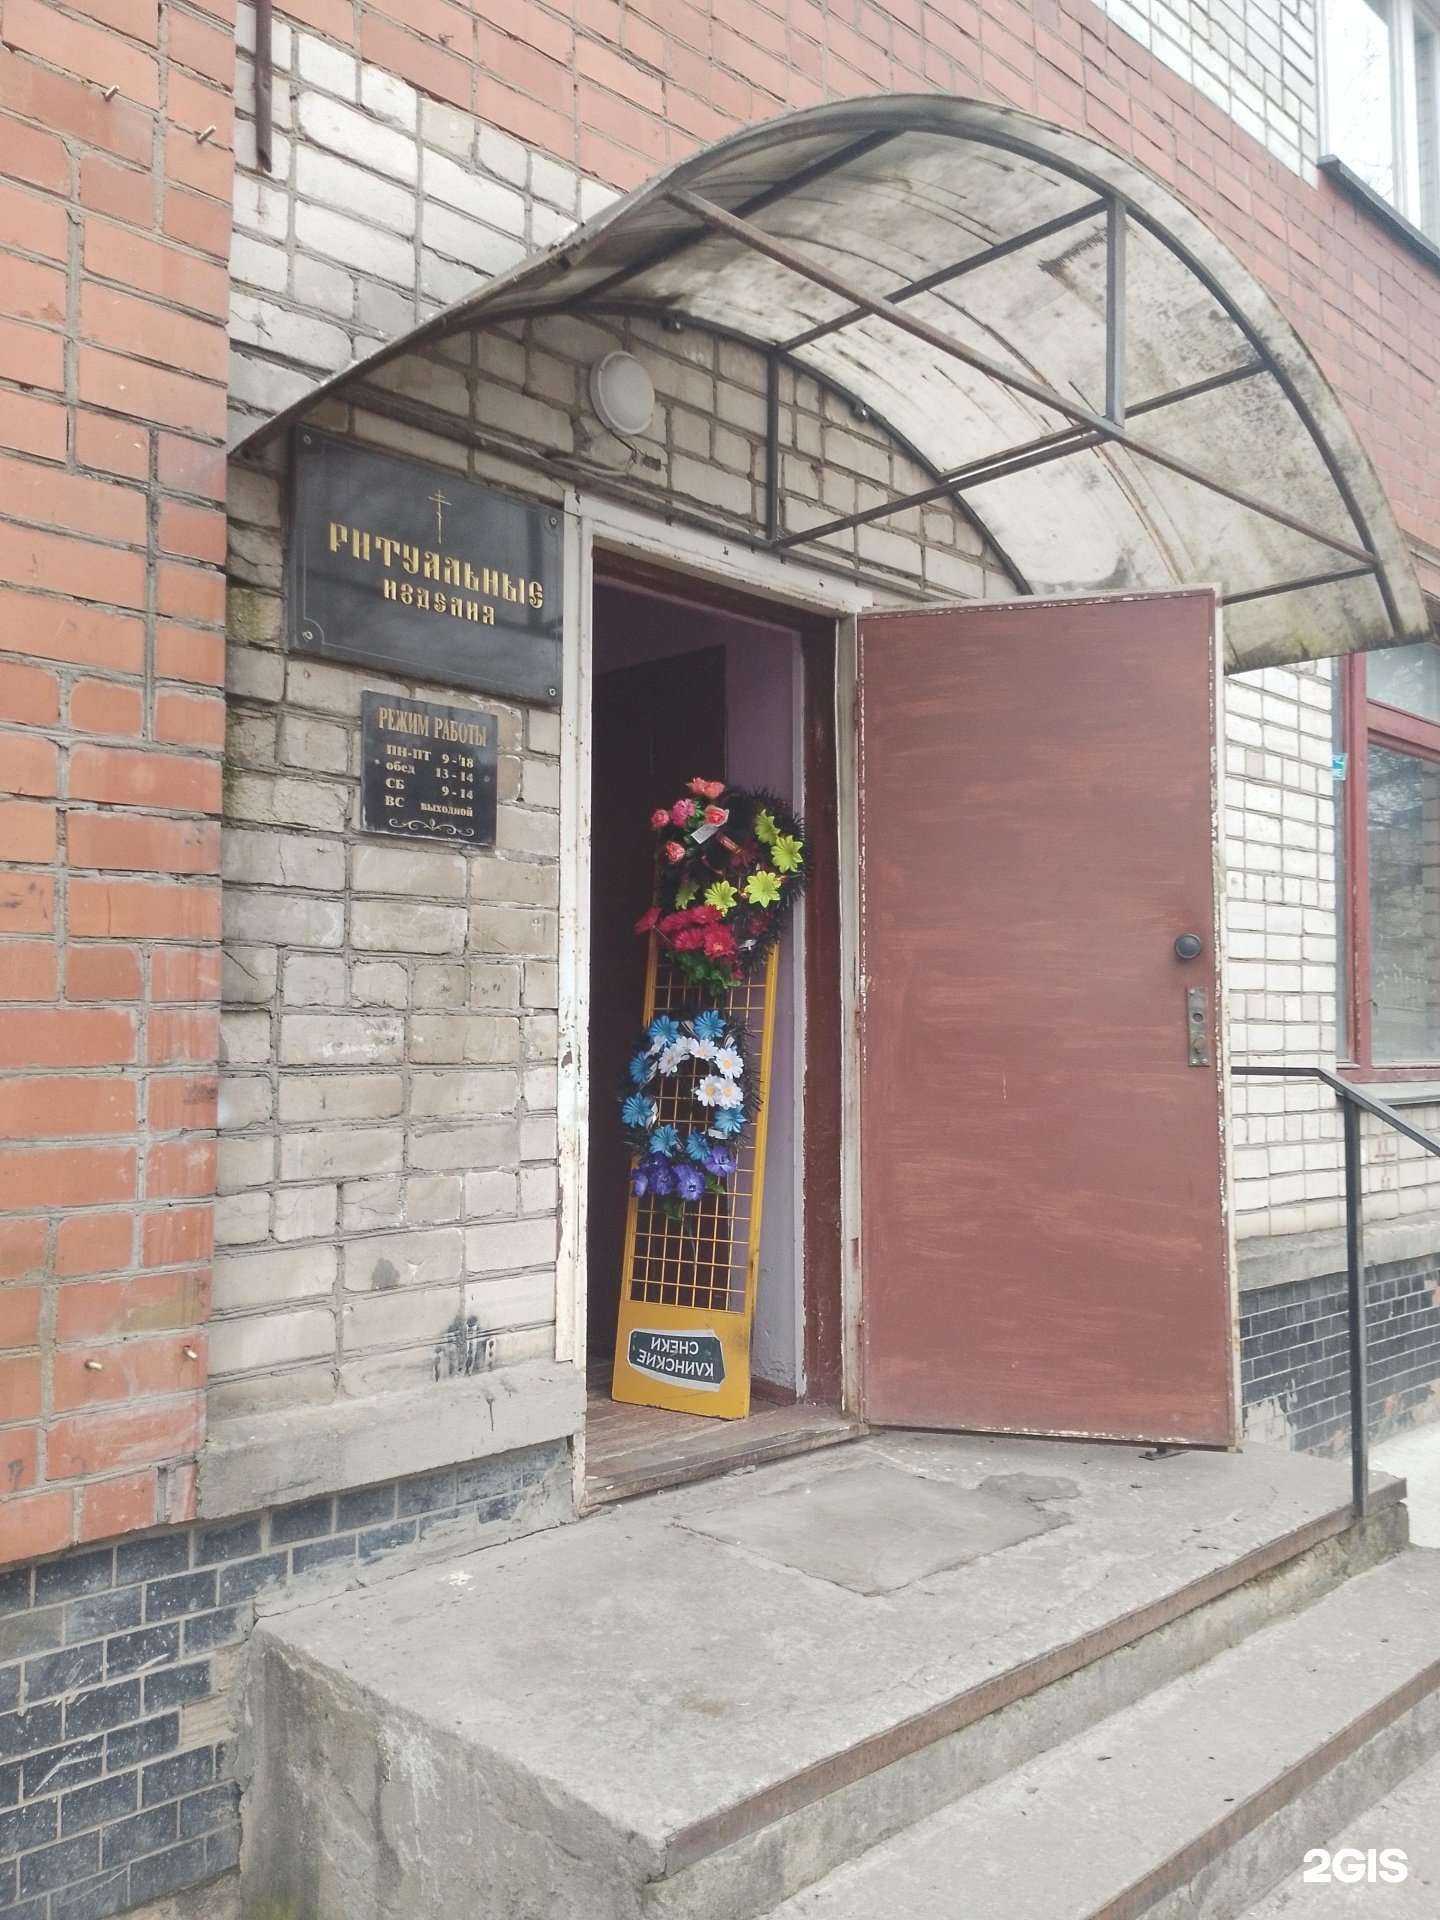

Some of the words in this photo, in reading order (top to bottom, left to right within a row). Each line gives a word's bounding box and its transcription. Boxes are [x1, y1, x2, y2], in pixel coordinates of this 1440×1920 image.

[329, 521, 544, 609] РИТУАЛЬНЫЕ
[378, 707, 429, 737] РЕЖИМ
[434, 717, 486, 747] РАБОТЫ
[386, 744, 432, 761] ПН-ПТ
[385, 762, 416, 775] обед
[385, 777, 405, 790] СБ
[384, 795, 405, 808] ВС
[420, 802, 473, 817] выходной
[650, 1337, 699, 1355] СНЕКИ
[637, 1349, 714, 1377] КЛИНСКИЕ
